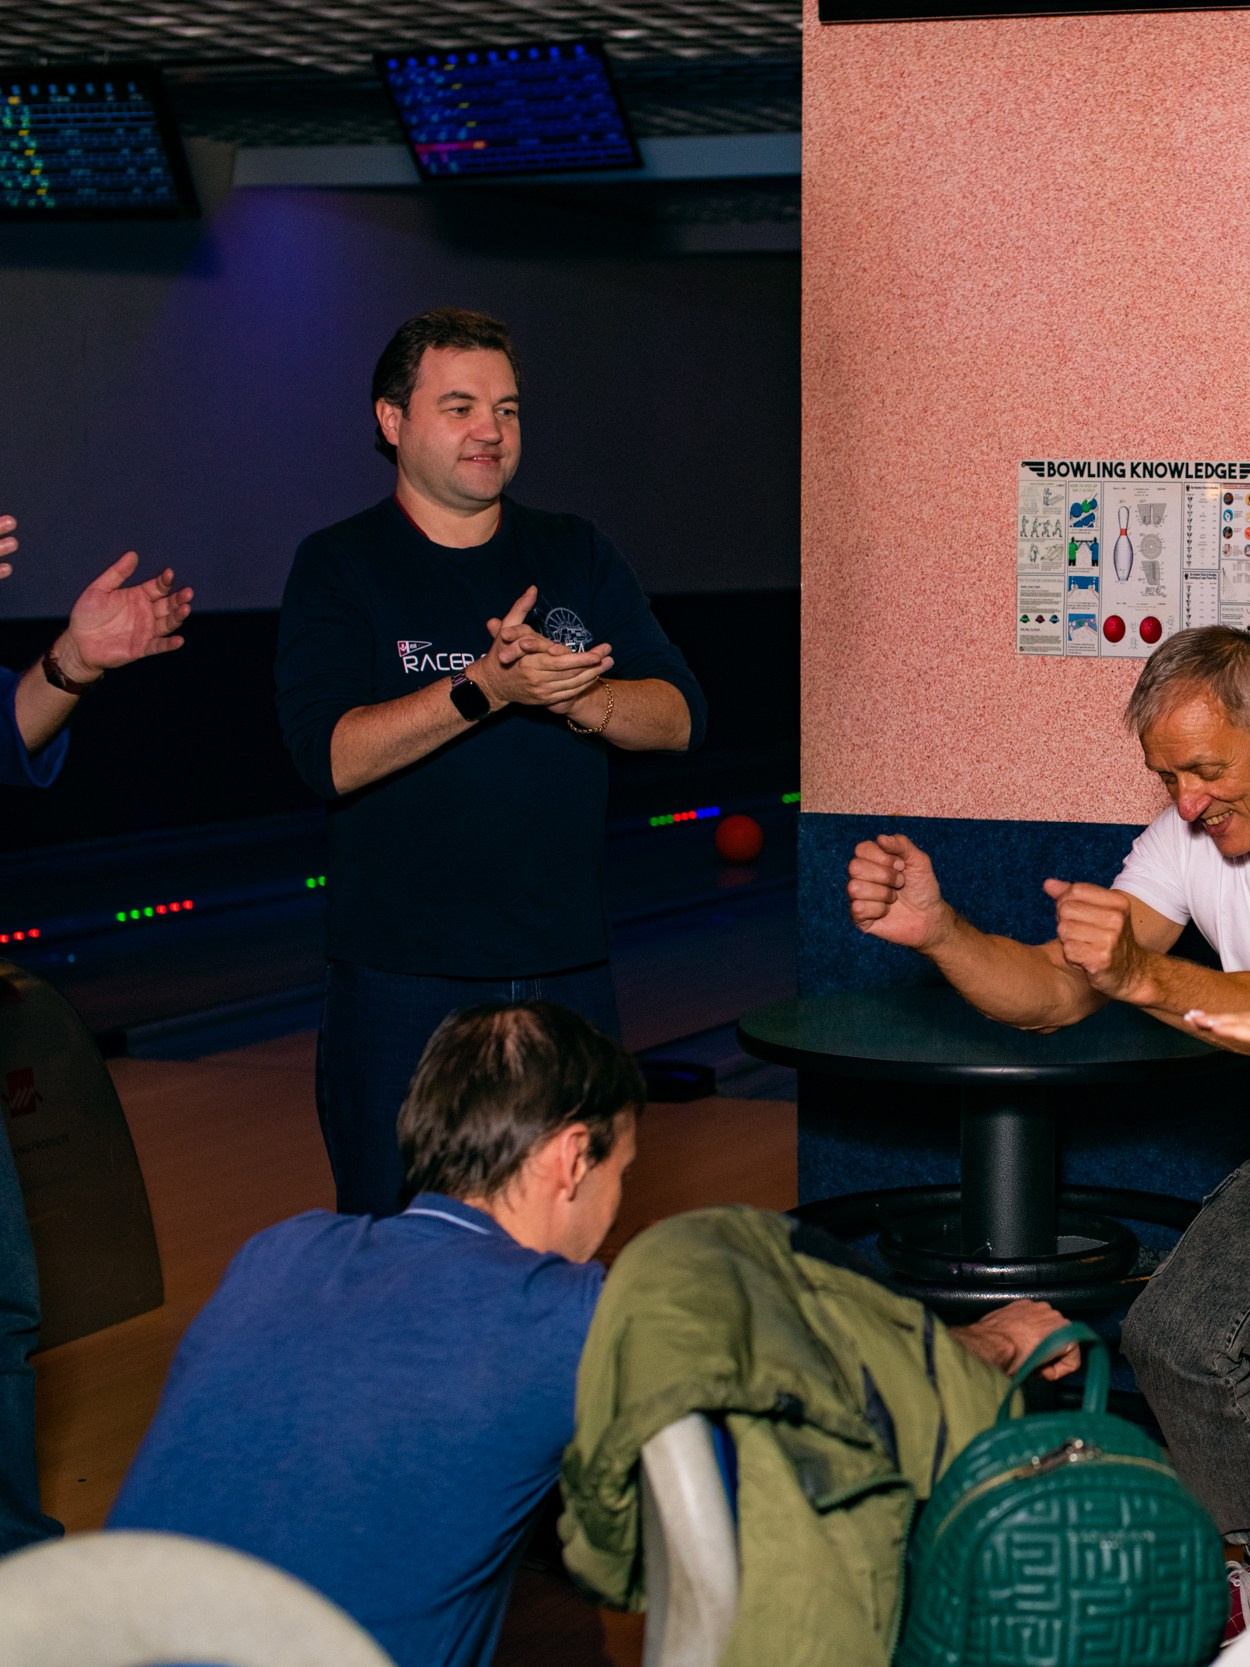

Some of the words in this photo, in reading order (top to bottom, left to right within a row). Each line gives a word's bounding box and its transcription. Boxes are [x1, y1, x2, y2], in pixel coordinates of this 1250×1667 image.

[1046, 461, 1126, 479] BOWLING
[1130, 462, 1238, 480] KNOWLEDGE
[402, 652, 475, 674] RACER
